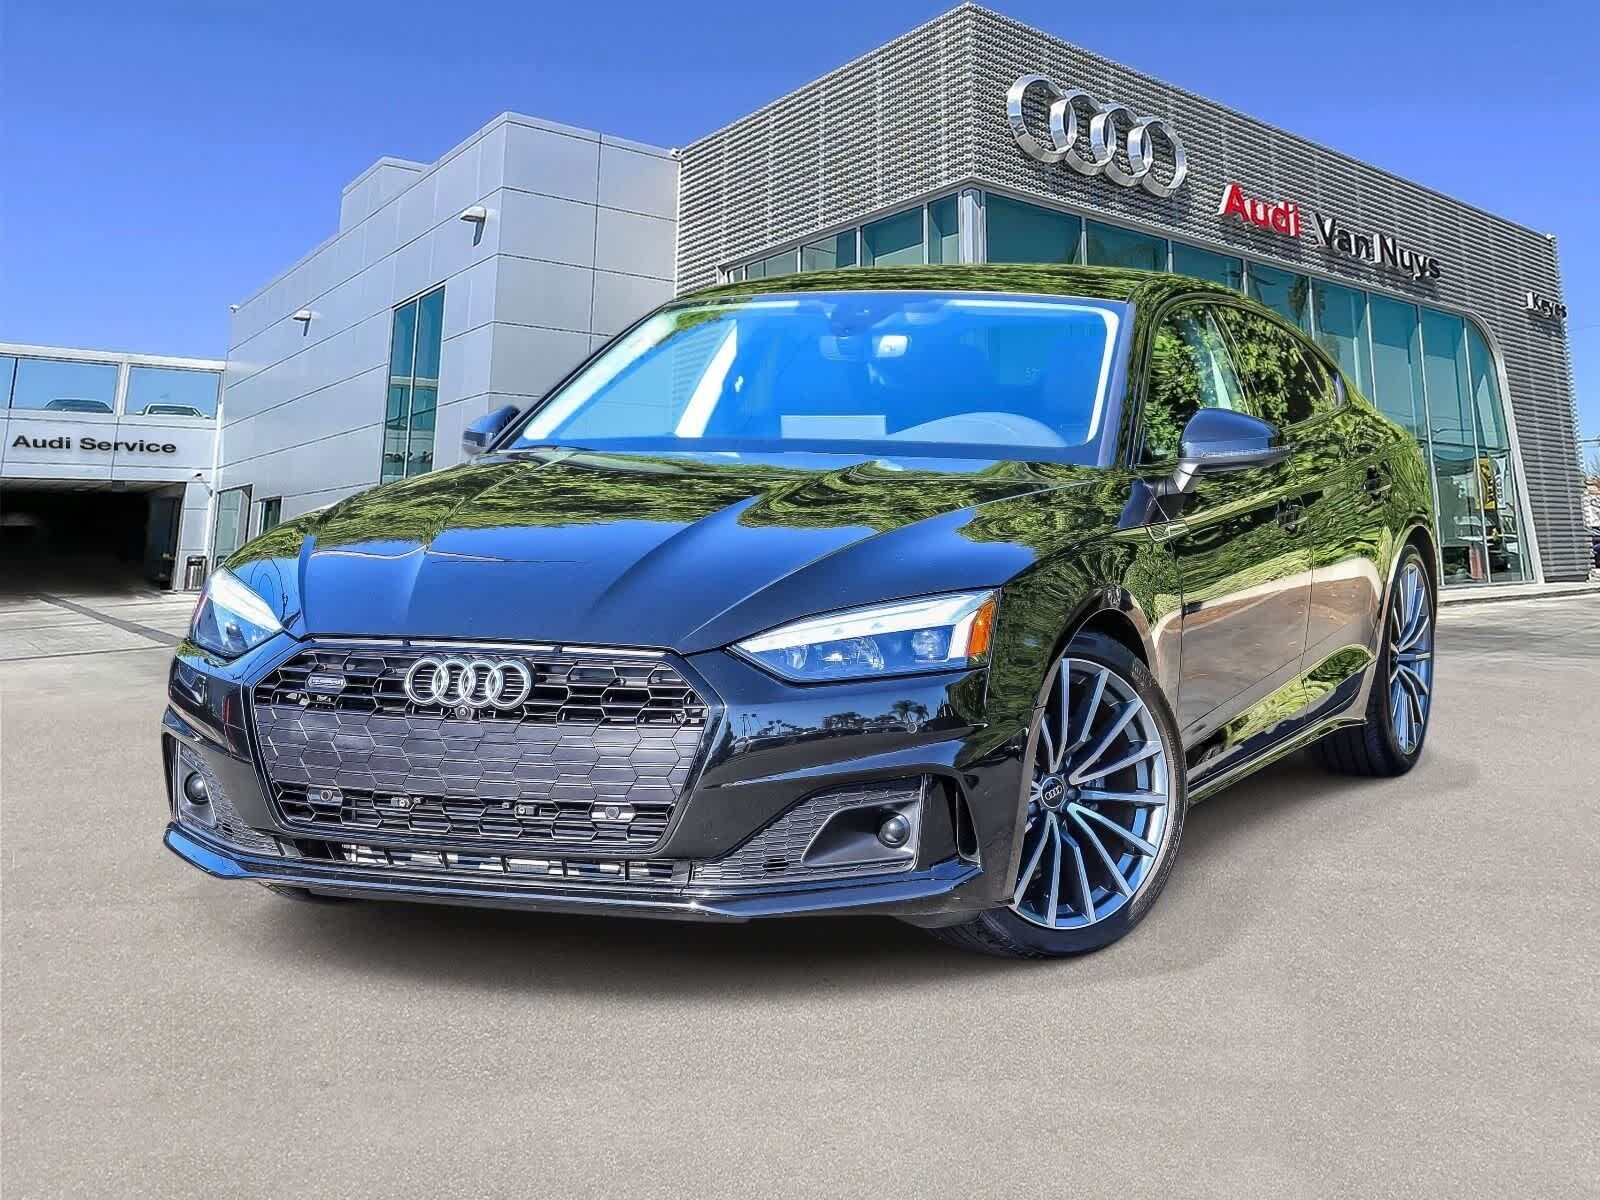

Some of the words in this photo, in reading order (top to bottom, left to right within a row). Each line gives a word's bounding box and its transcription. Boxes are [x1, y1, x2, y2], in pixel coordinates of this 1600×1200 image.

[1218, 182, 1302, 237] Audi
[1311, 211, 1372, 259] Van
[1373, 232, 1441, 281] Nuys
[12, 435, 72, 450] Audi
[79, 437, 178, 454] Service
